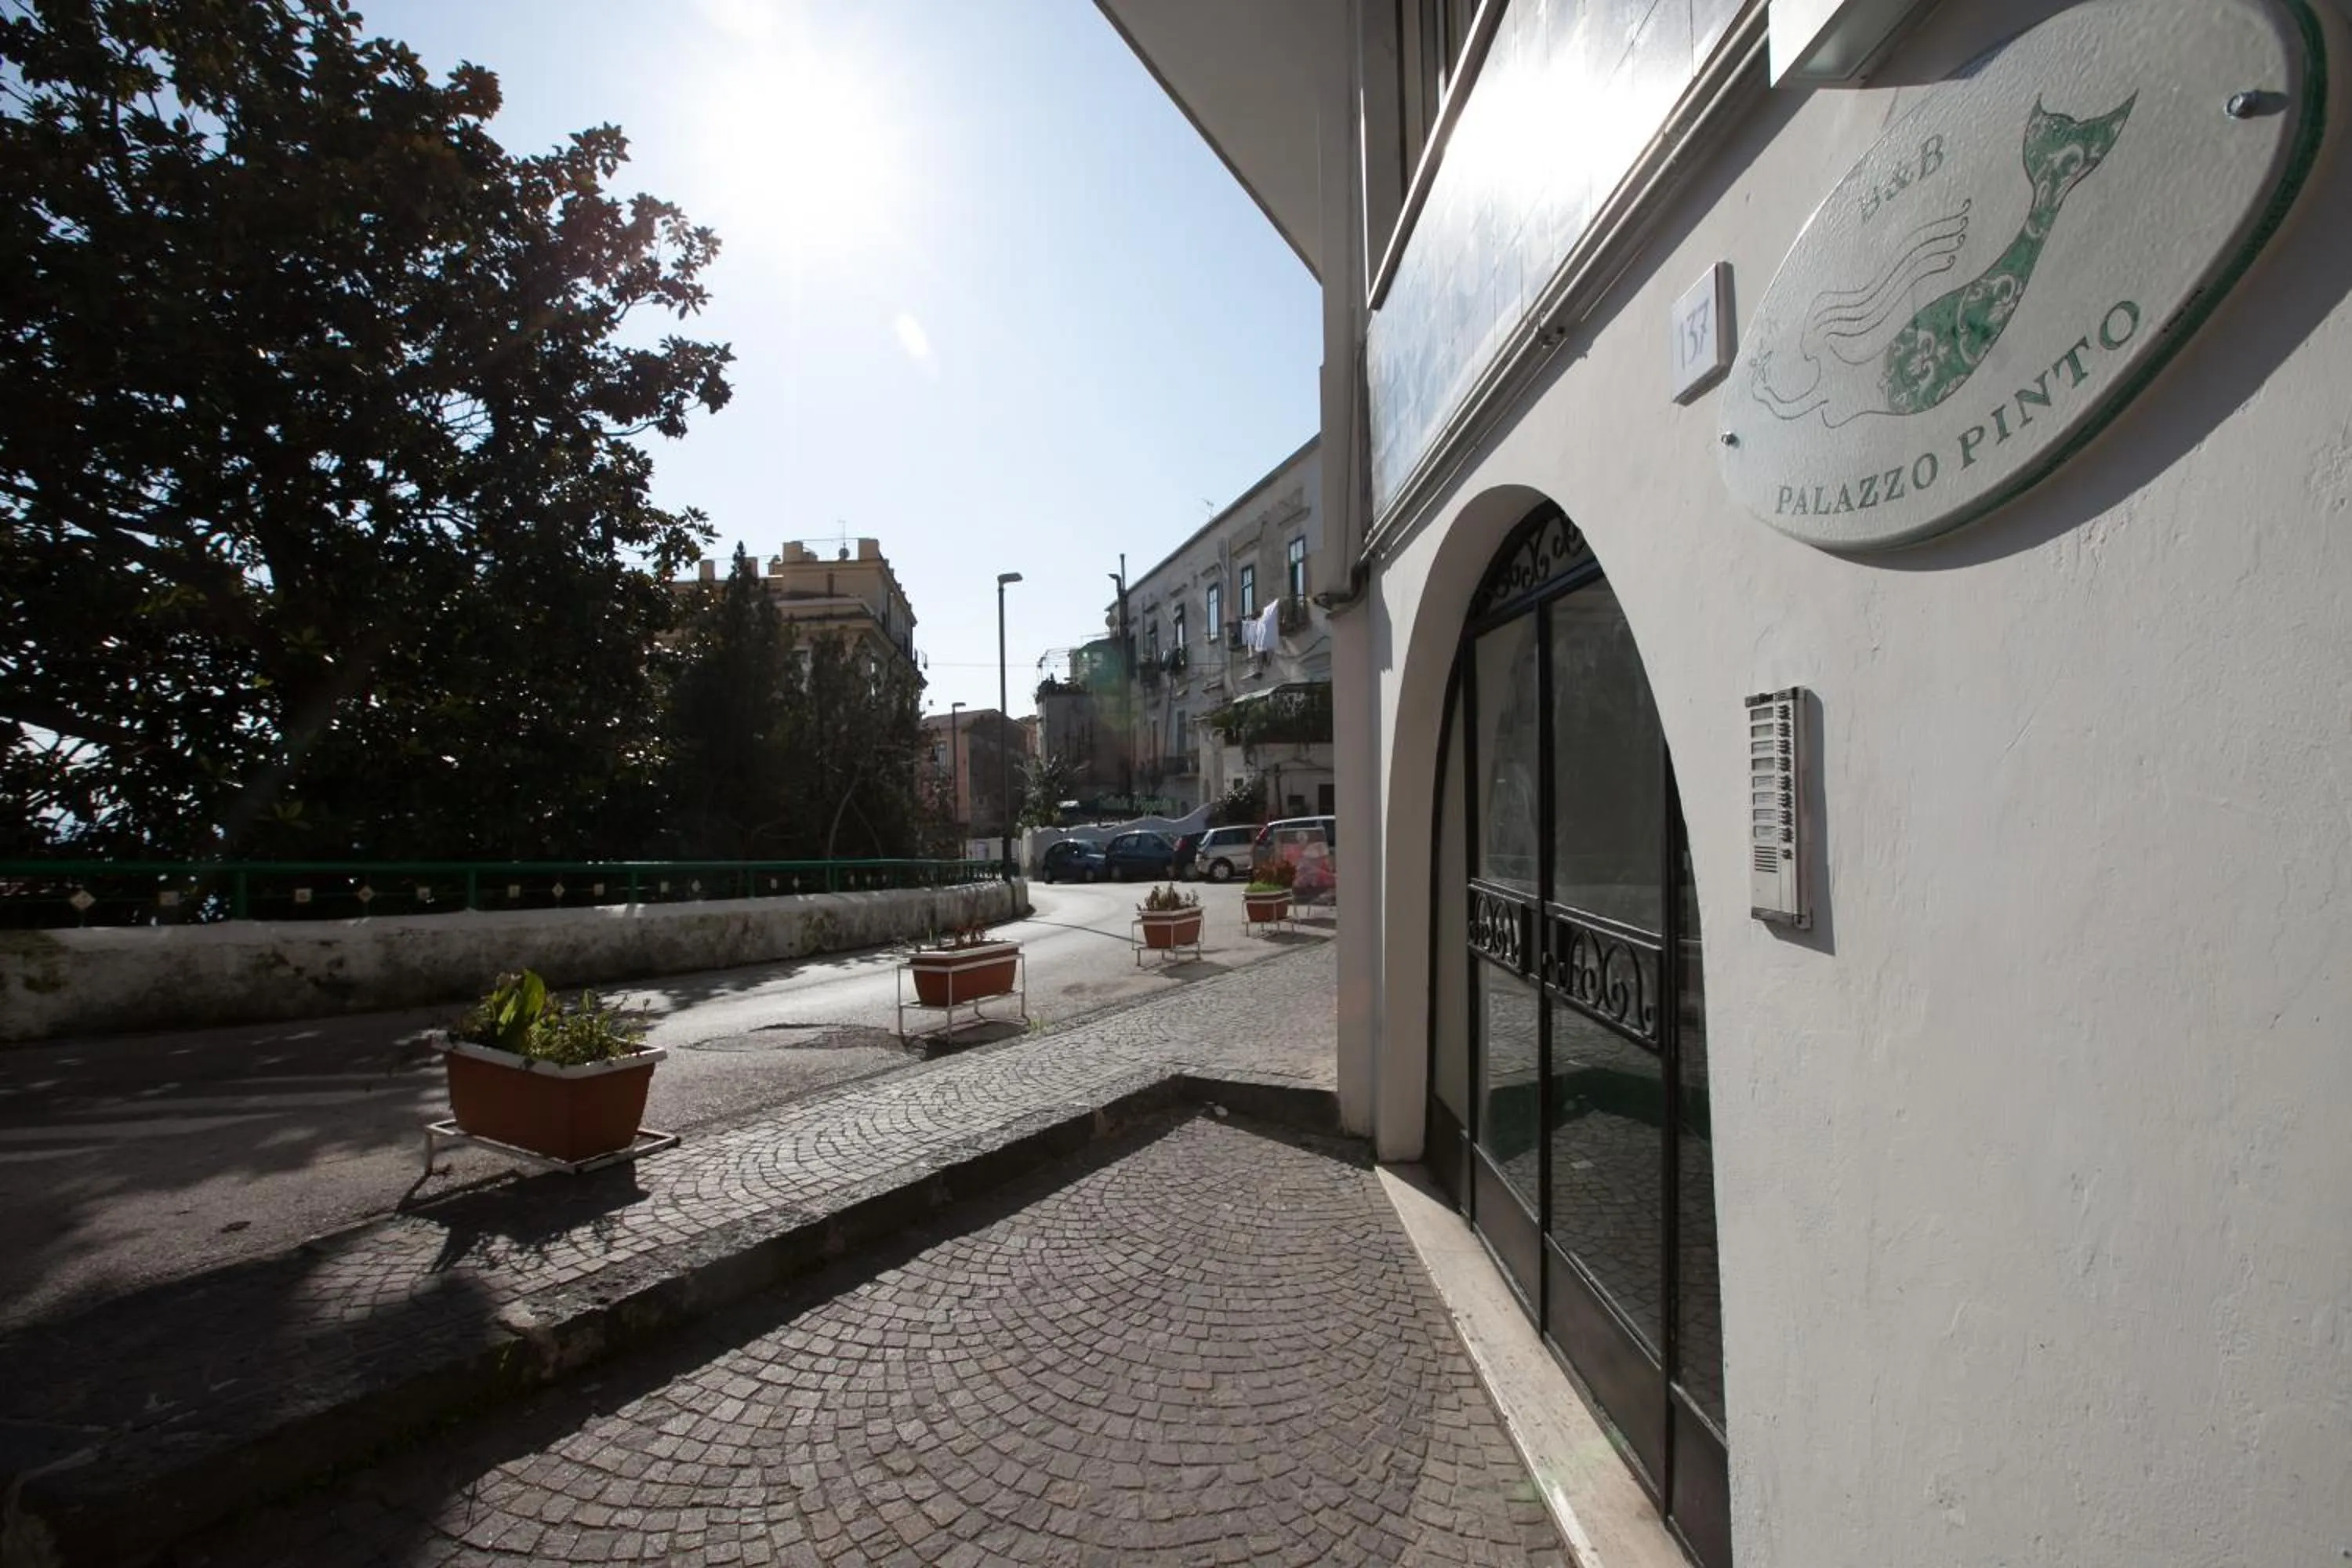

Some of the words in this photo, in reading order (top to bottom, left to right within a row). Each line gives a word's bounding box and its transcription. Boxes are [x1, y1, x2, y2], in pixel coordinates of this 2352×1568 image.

[1860, 133, 1944, 223] B&B
[1680, 298, 1710, 369] 137
[1775, 452, 1939, 516] PALAZZO
[1957, 301, 2141, 470] PINTO
